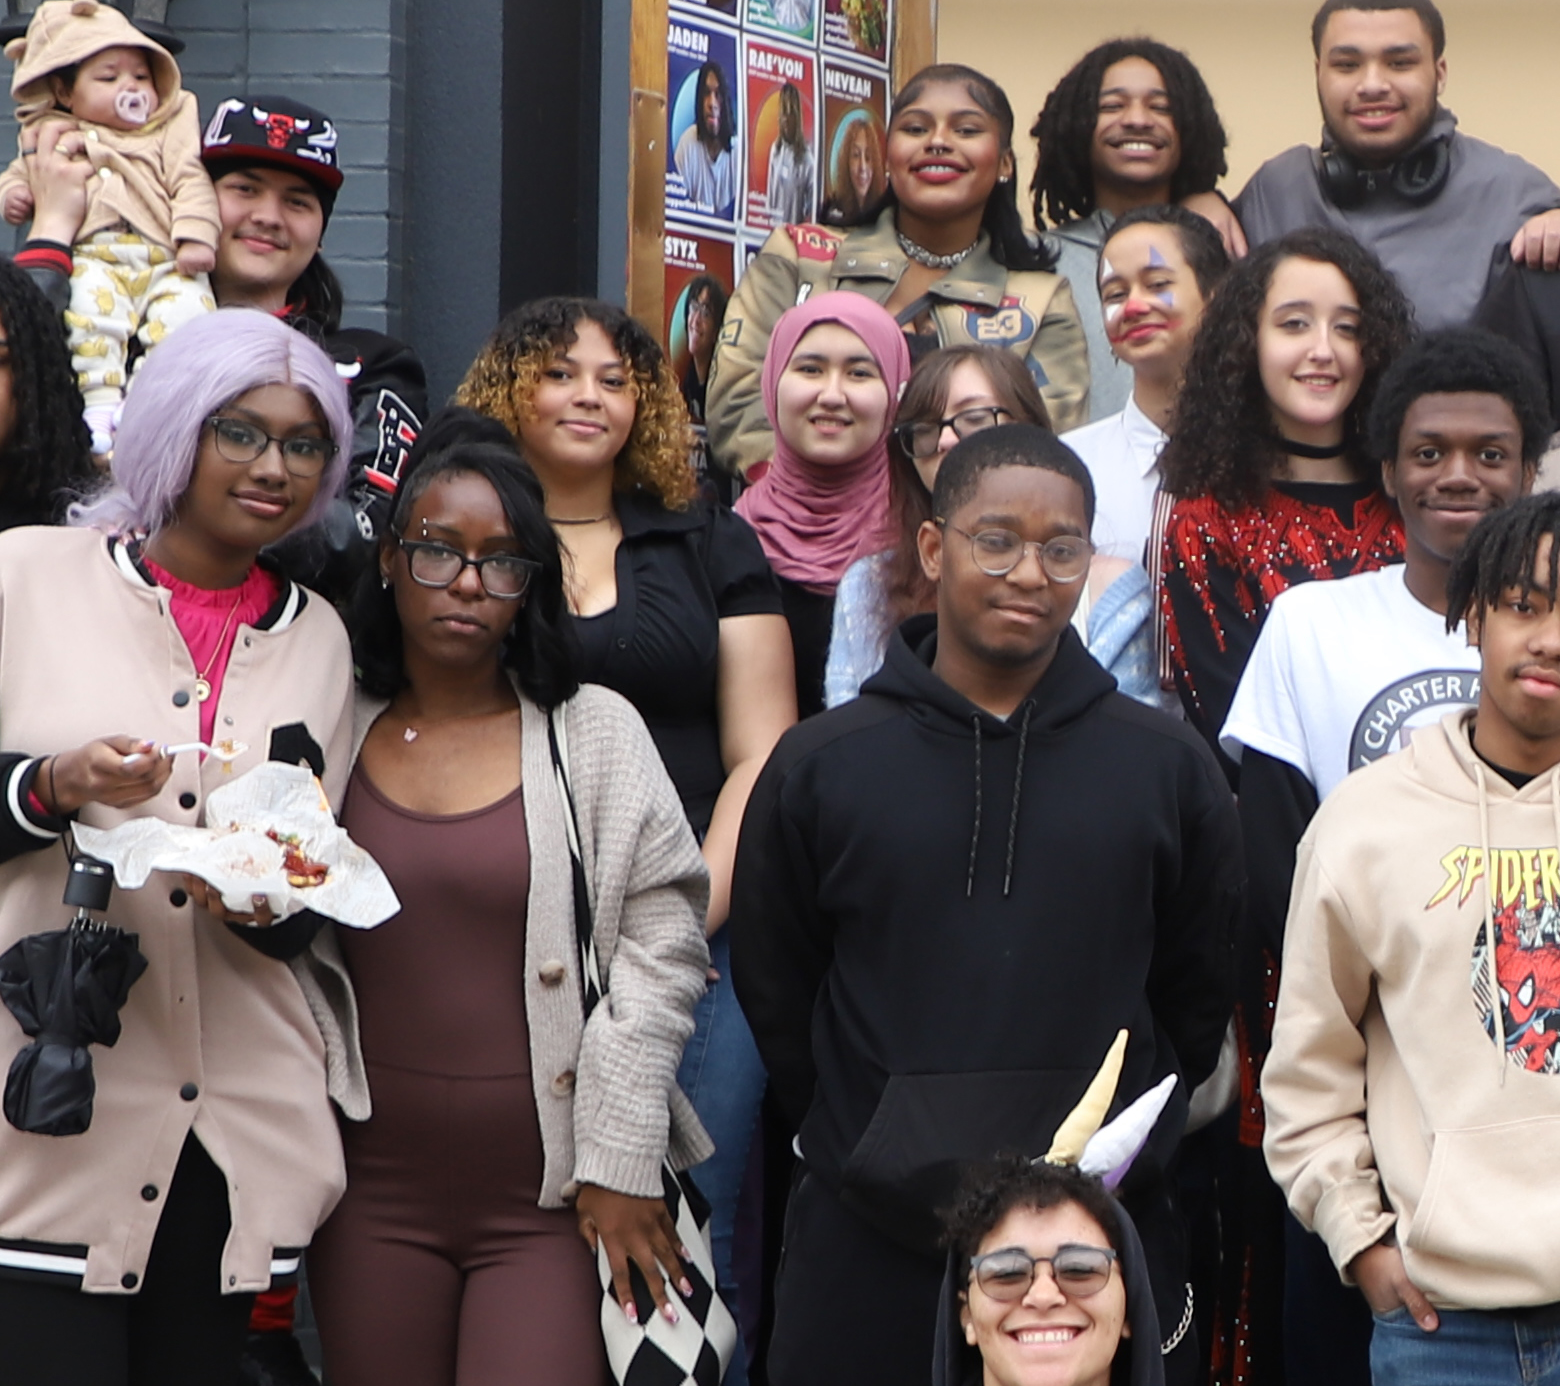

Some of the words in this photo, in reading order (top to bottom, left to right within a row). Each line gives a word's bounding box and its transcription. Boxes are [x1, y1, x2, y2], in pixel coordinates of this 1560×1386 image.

[667, 24, 709, 54] JADEN
[748, 48, 804, 80] RAE'VON
[825, 68, 872, 98] NEVEAH
[664, 235, 698, 261] STYX
[1364, 675, 1462, 751] CHARTER
